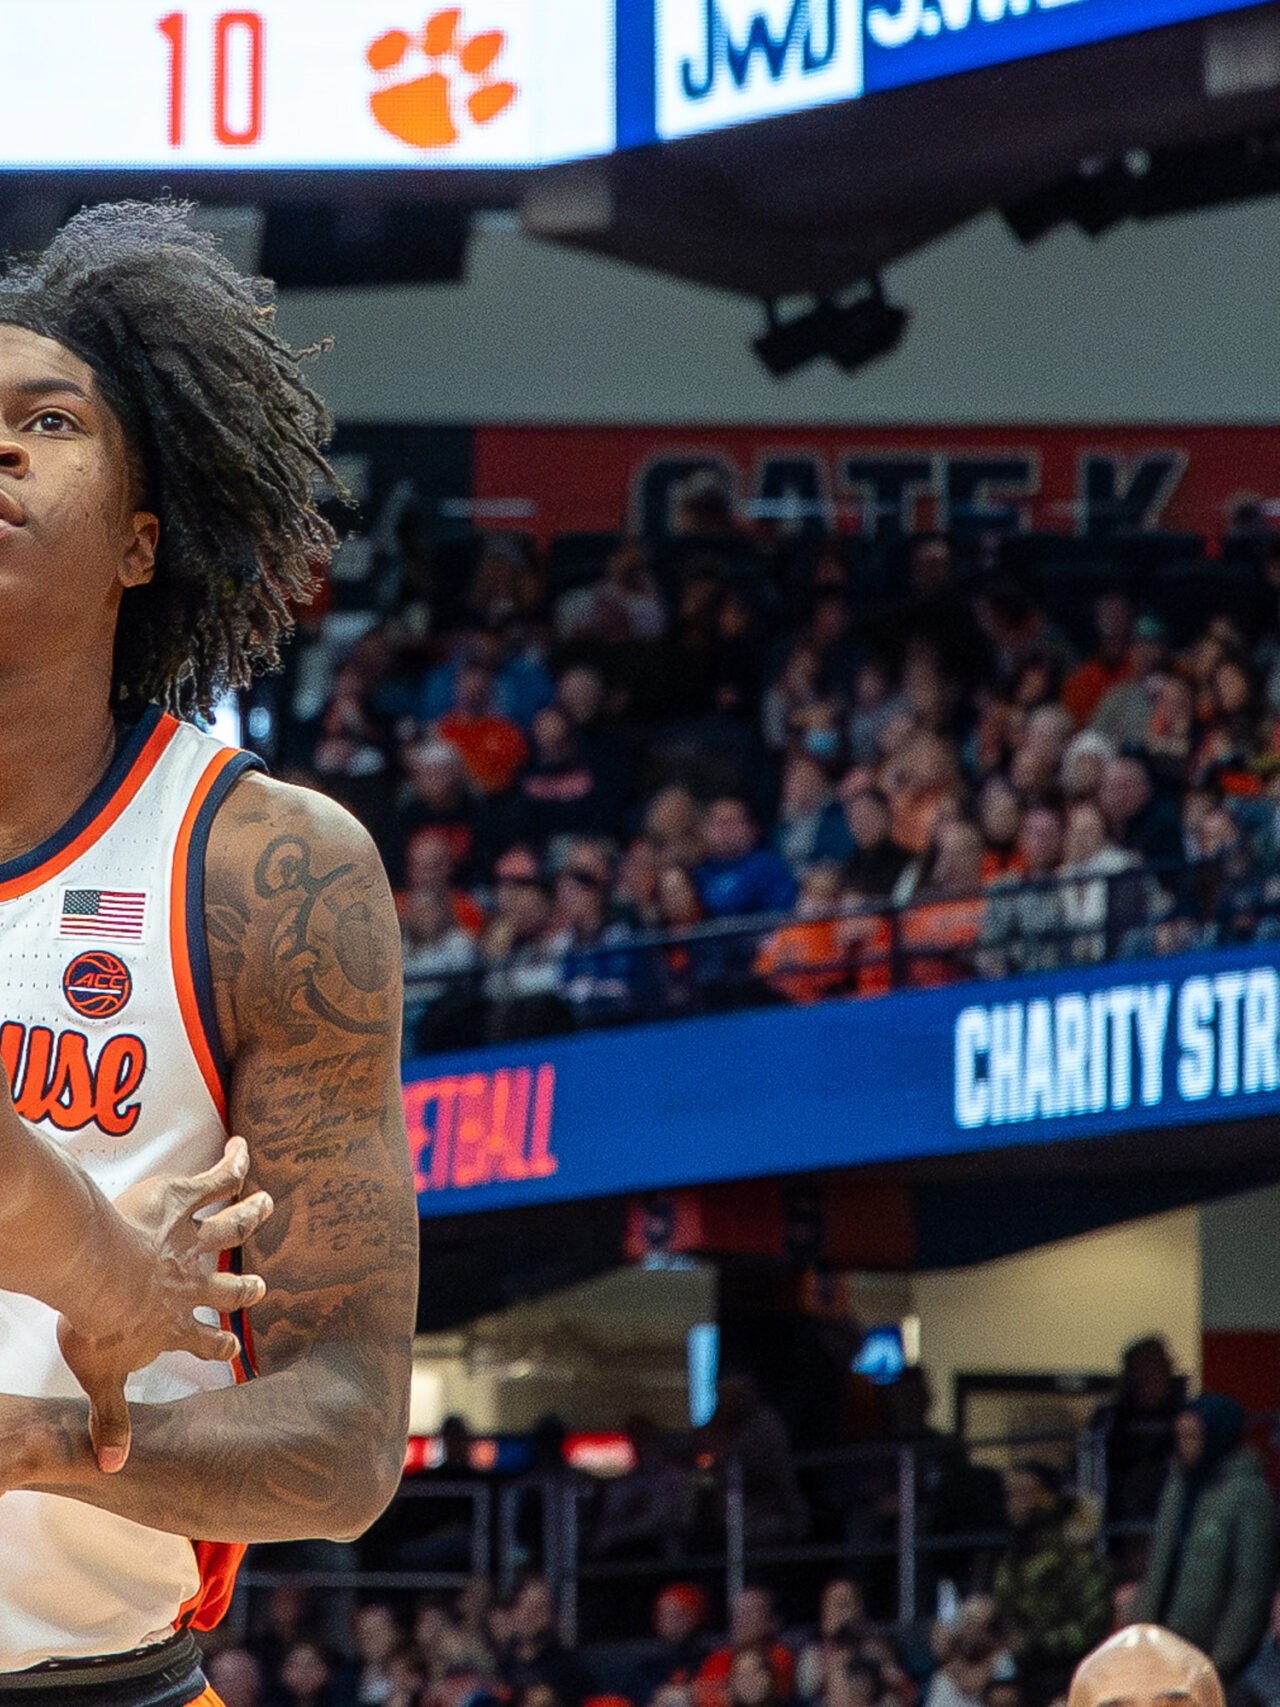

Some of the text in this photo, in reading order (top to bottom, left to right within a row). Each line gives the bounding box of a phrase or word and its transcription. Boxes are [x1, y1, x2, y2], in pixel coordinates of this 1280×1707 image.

[156, 11, 265, 149] 10
[73, 971, 129, 990] ACC
[954, 965, 1280, 1130] CHARITY STR
